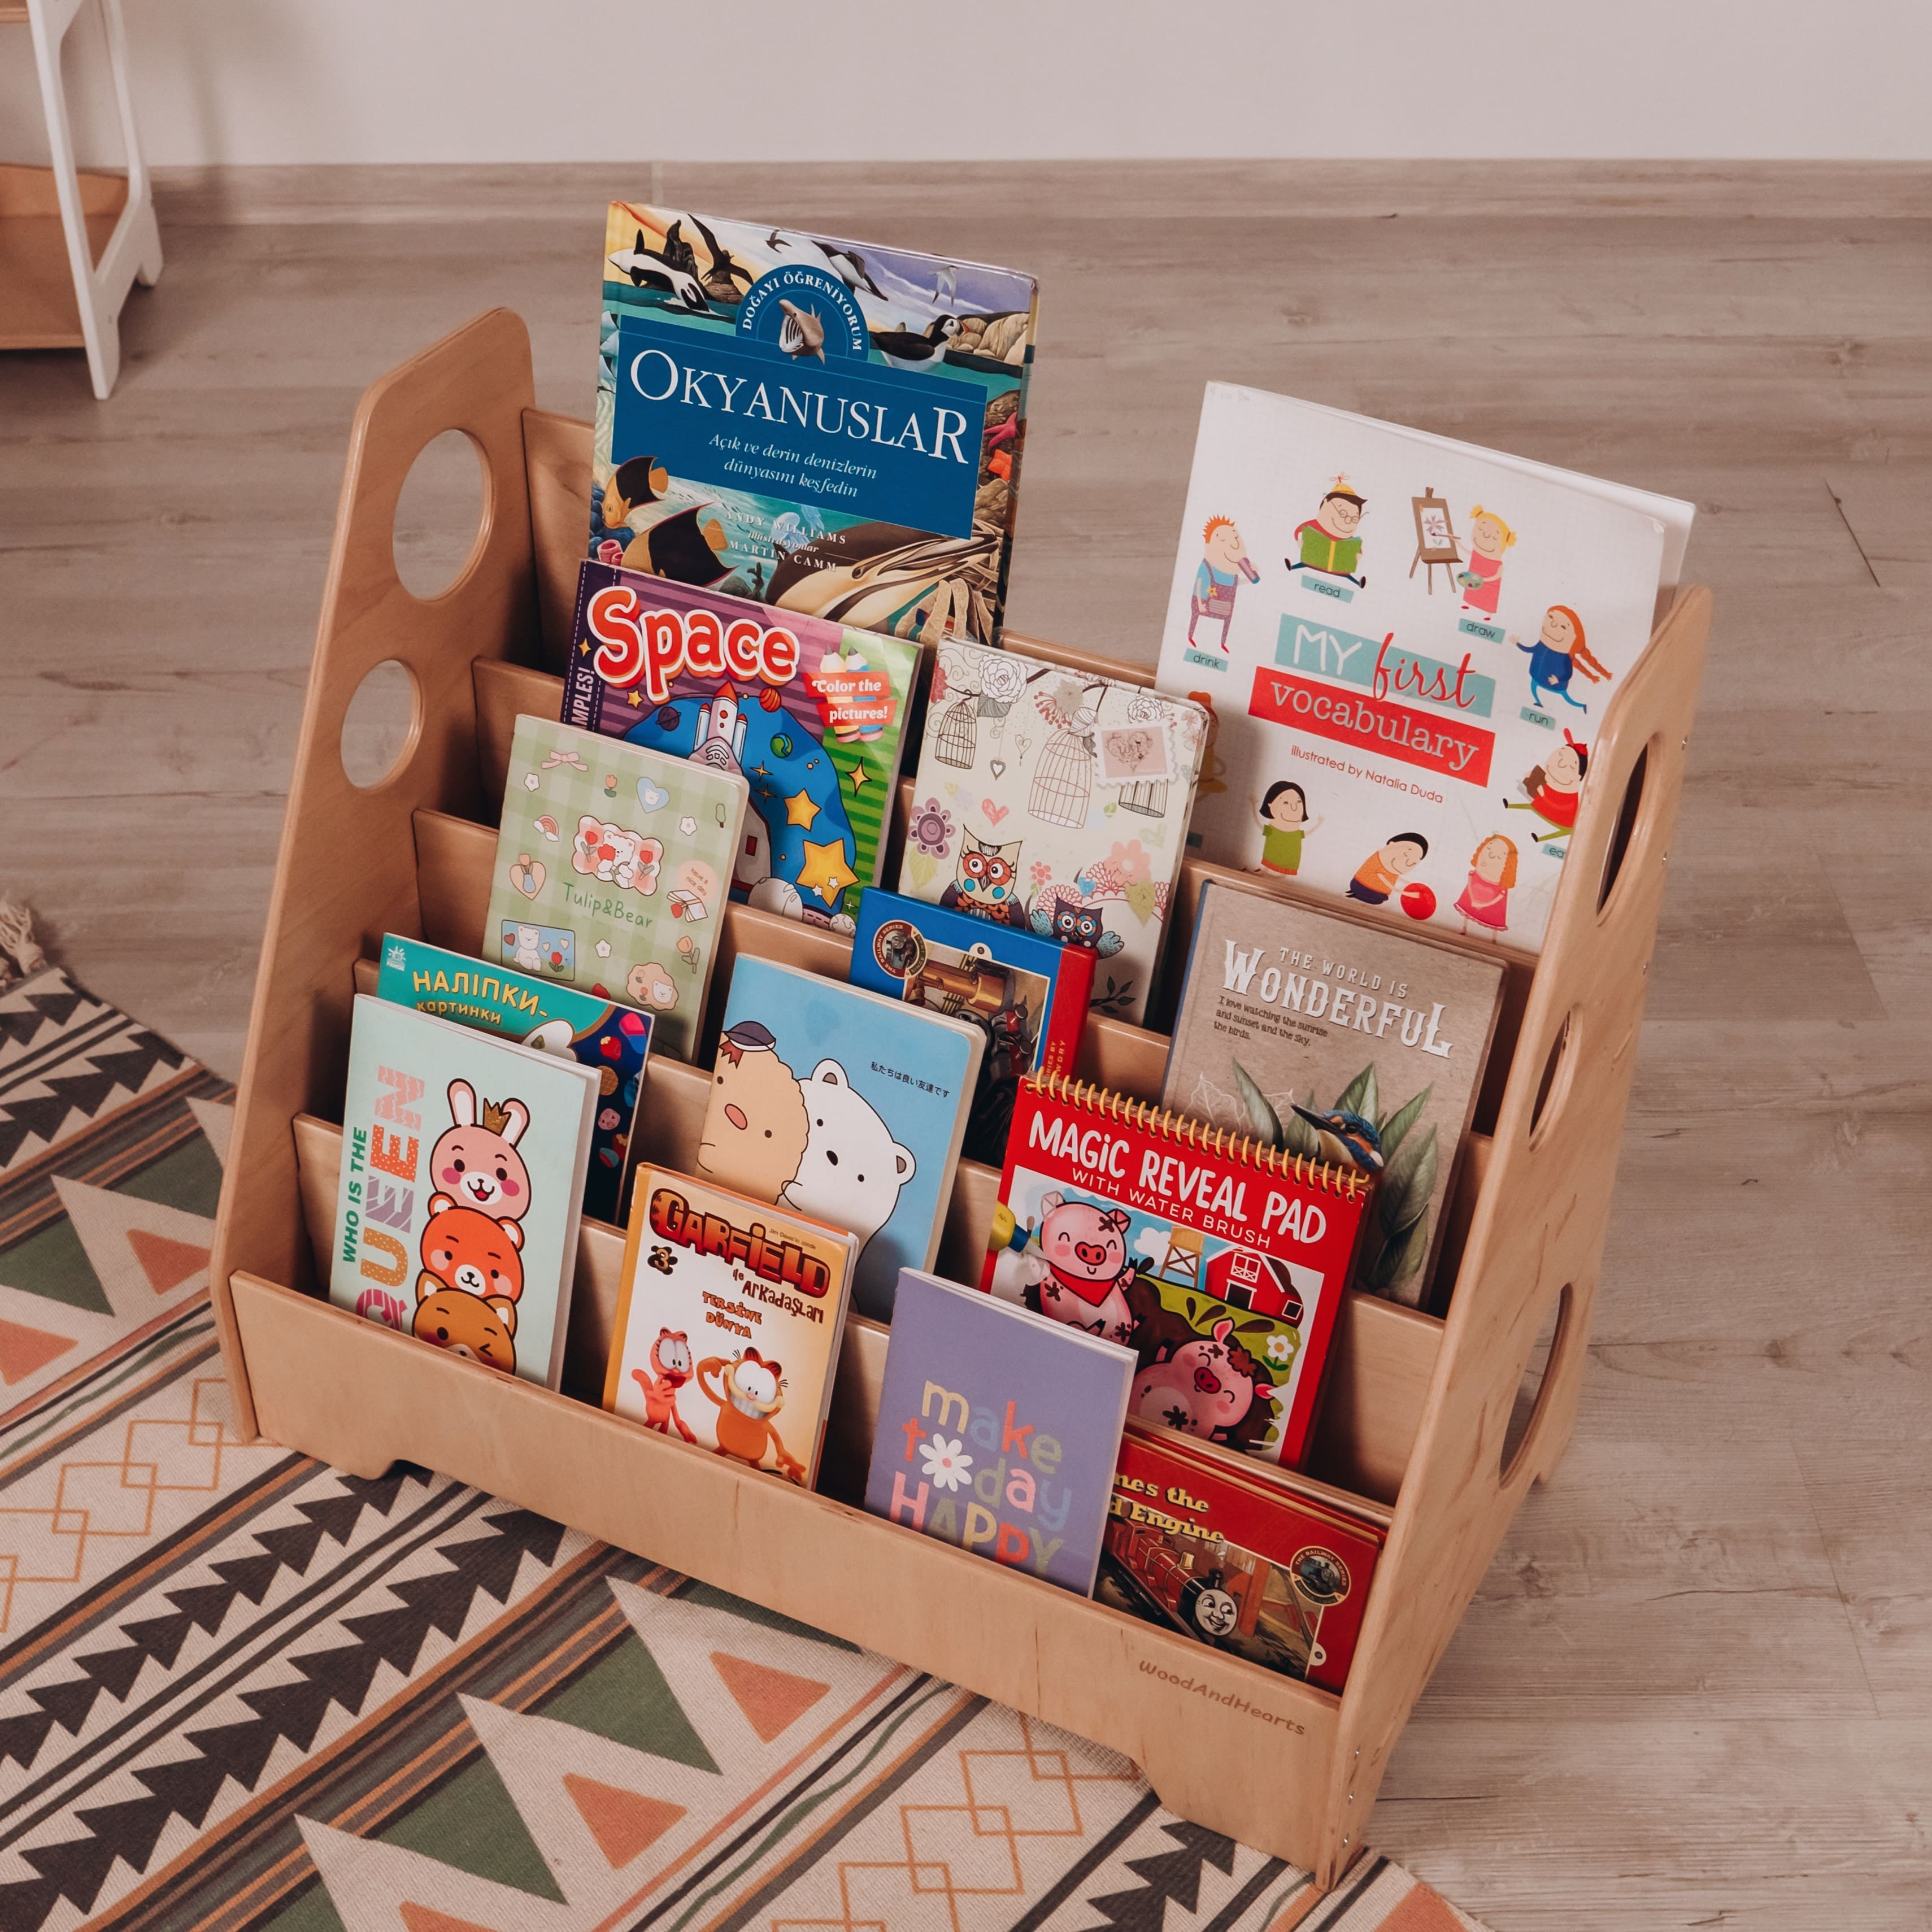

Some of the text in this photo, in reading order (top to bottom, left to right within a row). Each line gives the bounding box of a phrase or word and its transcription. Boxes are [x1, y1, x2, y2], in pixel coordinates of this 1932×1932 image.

[742, 271, 863, 351] DOĞAYI ÖĞRENİYORUM
[630, 349, 969, 464] OKYANUSLAR
[708, 434, 877, 479] Açık ve derin denizlerin
[724, 458, 858, 497] dünyasını keşfedin
[725, 511, 846, 544] ANDY WILLIAMS
[729, 541, 837, 572] MARTIN CAMM
[1313, 581, 1341, 598] read
[586, 585, 800, 703] Space
[1466, 621, 1495, 639] draw
[1193, 654, 1220, 669] drink
[1293, 624, 1476, 709] MY first
[571, 667, 595, 729] MPLES!
[811, 679, 882, 693] Color the
[829, 706, 888, 724] pictures!
[1270, 681, 1479, 771] vocabulary
[1529, 712, 1548, 725] run
[1290, 745, 1443, 803] illustrated by Natalia Duda
[1549, 847, 1567, 858] ea
[686, 876, 707, 897] nice day
[691, 868, 704, 881] have
[563, 882, 653, 928] Tulip&Bear
[1280, 947, 1408, 999] THE WORLD IS
[416, 1000, 502, 1025] картинки
[1218, 995, 1328, 1037] I love watching the sunrise
[1222, 939, 1454, 1059] WONDERFUL
[1214, 1021, 1251, 1040] the birds.
[1216, 1009, 1232, 1020] and
[1233, 1014, 1260, 1029] sunset
[1261, 1023, 1277, 1035] and
[1279, 1029, 1293, 1040] the
[1046, 1041, 1056, 1076] RIES BY
[1056, 1040, 1066, 1077] WDRY
[870, 1061, 950, 1098] 私たちは良い友達です
[342, 1126, 367, 1264] WHO IS THE
[356, 1064, 425, 1331] QUEEN
[1072, 1167, 1271, 1249] WITH WATER BRUSH
[1139, 1150, 1247, 1222] REVEAL
[1261, 1191, 1326, 1244] PAD
[654, 1247, 671, 1270] 3
[702, 1290, 762, 1325] TERSİNE
[706, 1311, 752, 1339] DÜNYA
[921, 1380, 1063, 1474] make
[1166, 1487, 1209, 1513] the
[889, 1470, 1065, 1579] HAPPY
[1130, 1500, 1224, 1544] Engine
[1139, 1659, 1306, 1735] WoodAndHearts
